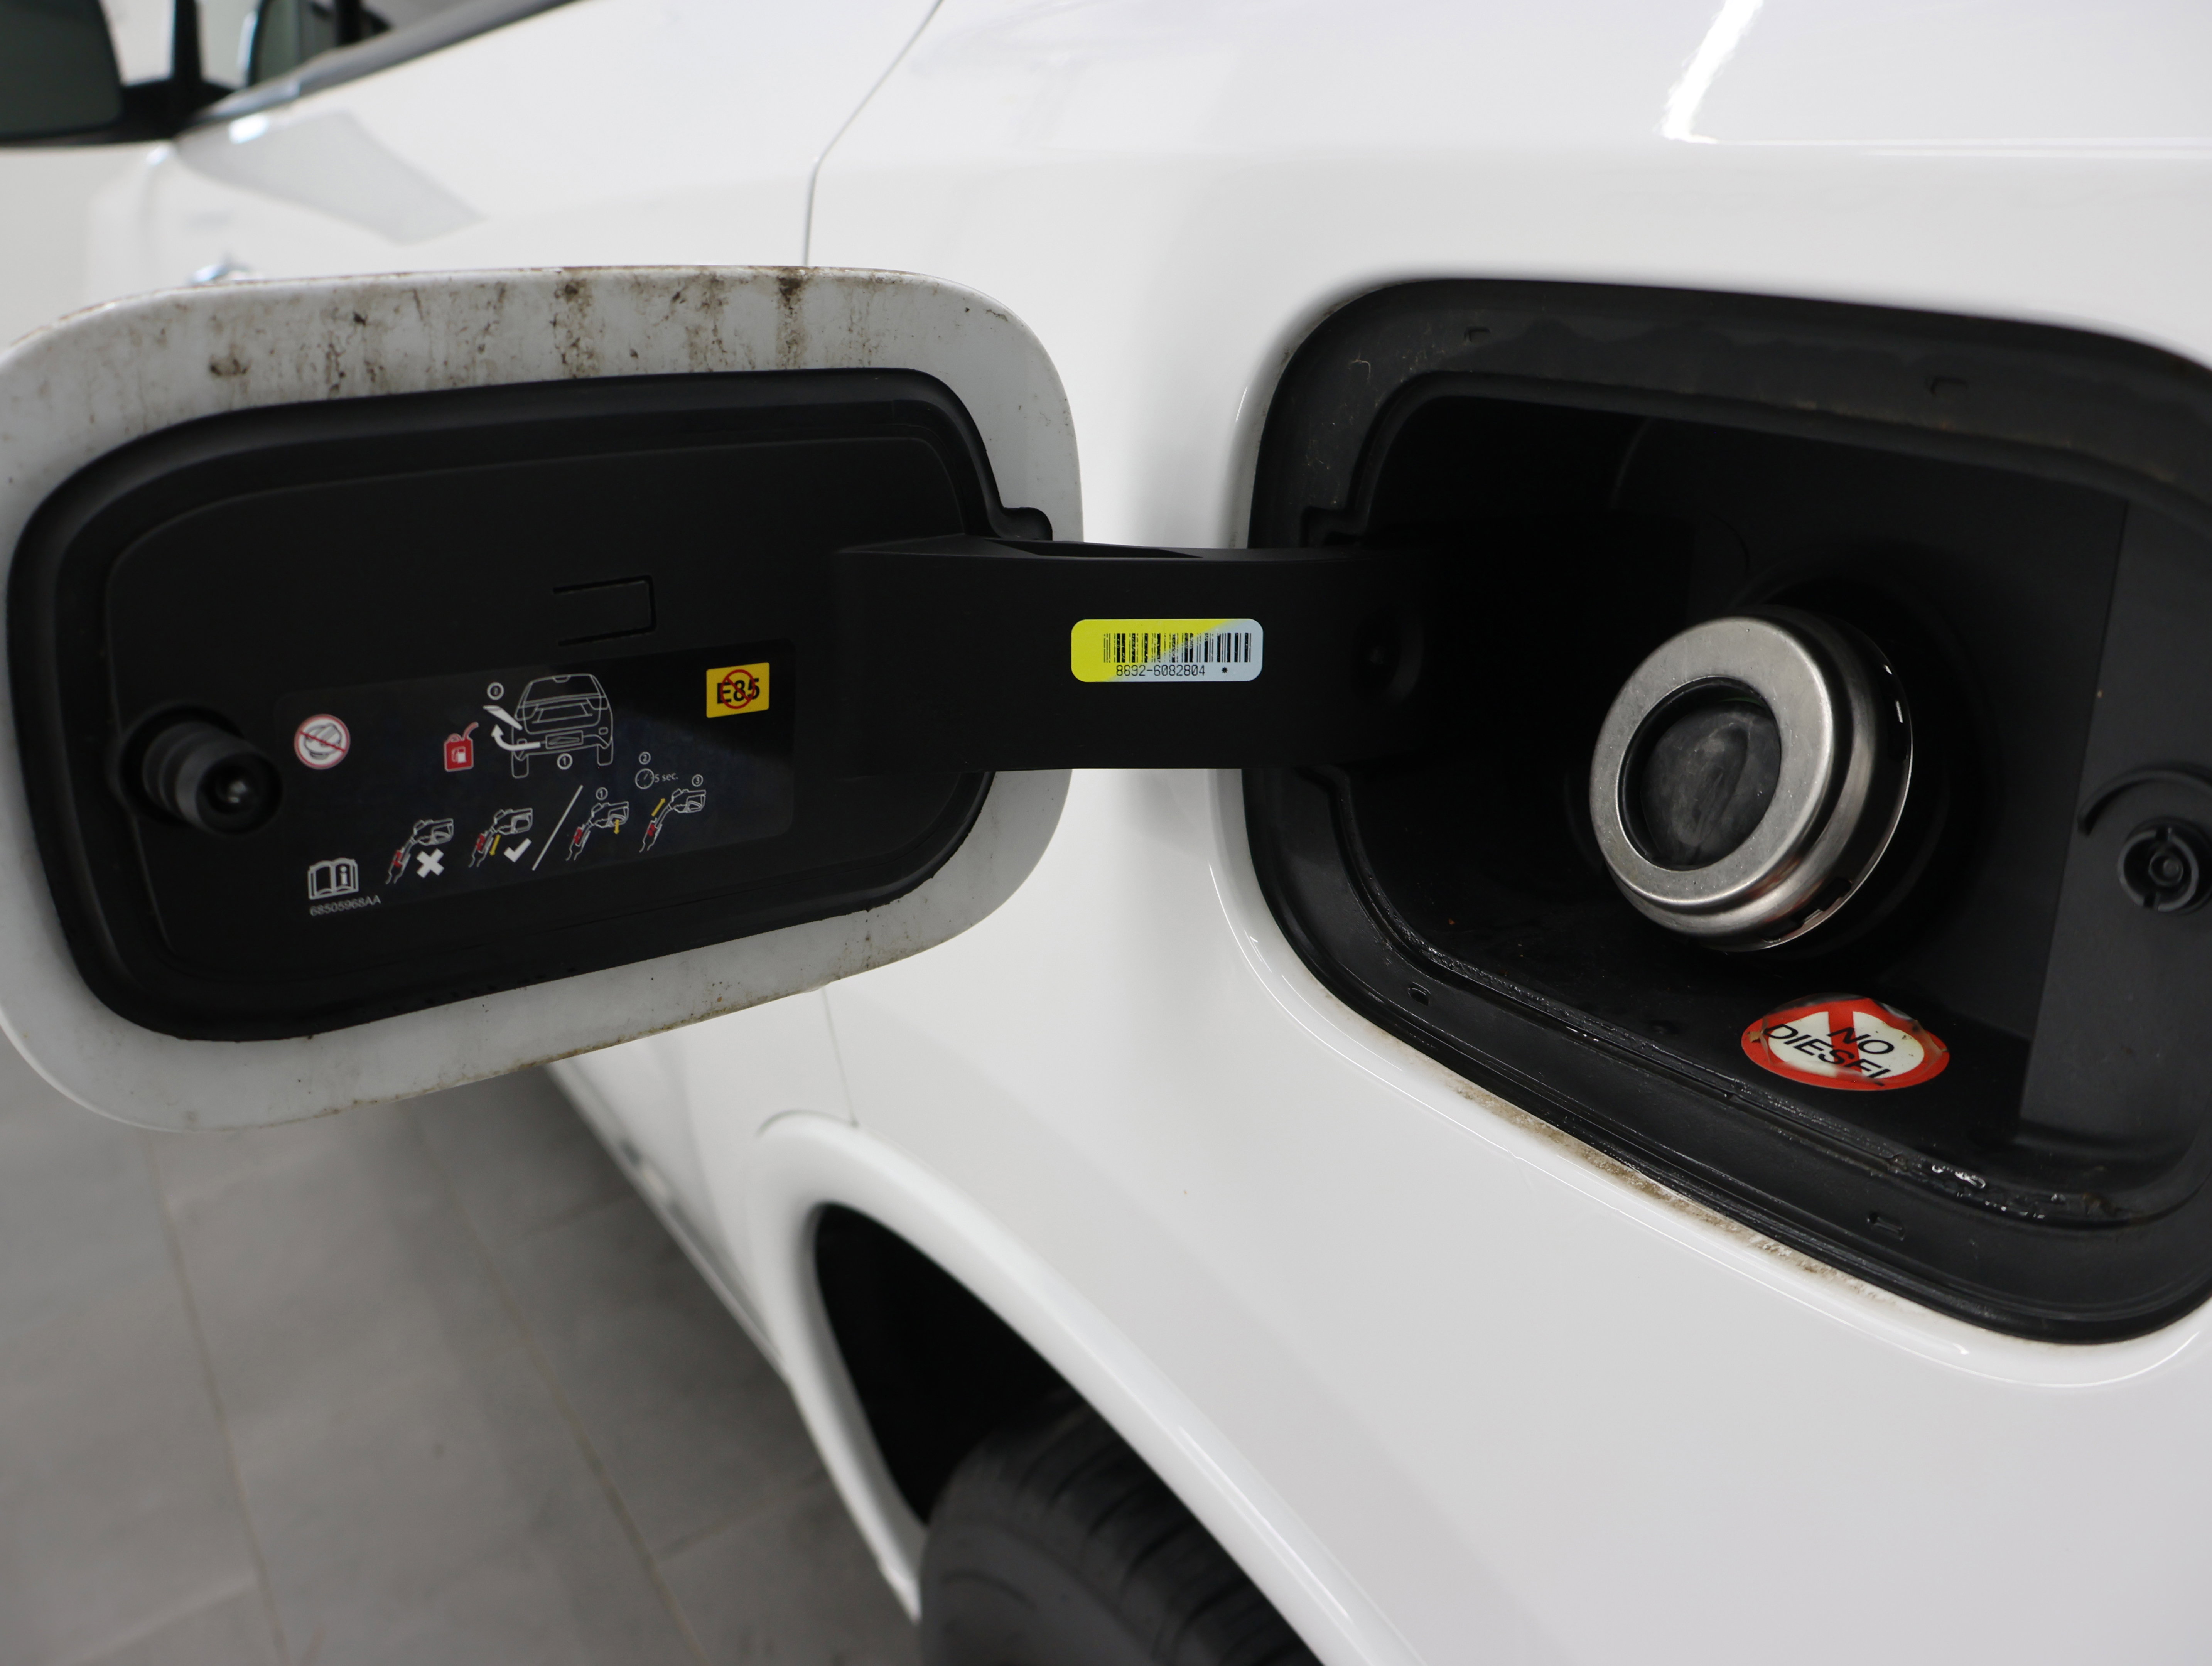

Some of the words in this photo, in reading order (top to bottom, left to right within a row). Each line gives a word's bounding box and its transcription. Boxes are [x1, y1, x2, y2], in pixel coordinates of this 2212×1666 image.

[717, 678, 760, 703] E85
[655, 774, 659, 782] 5
[662, 773, 678, 781] sec.
[1826, 1027, 1894, 1055] NO
